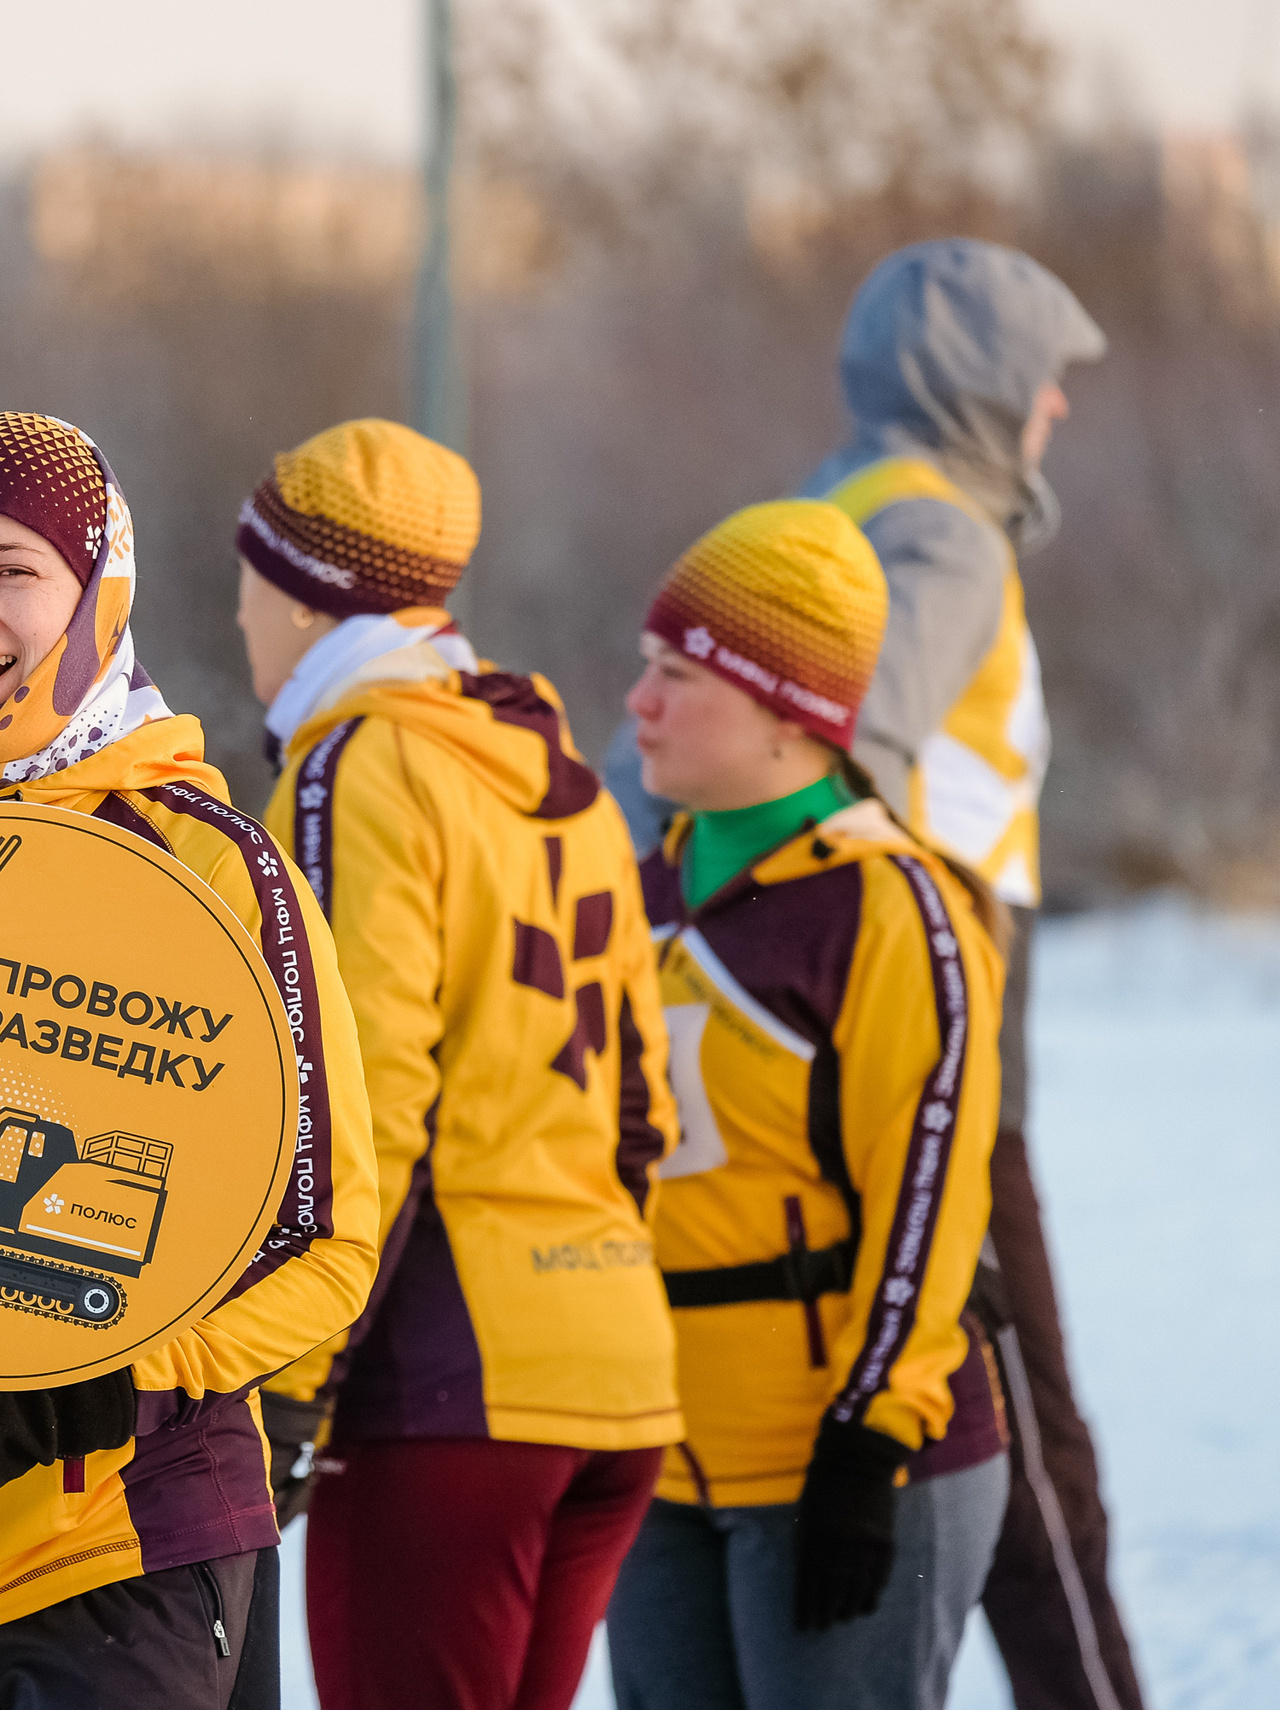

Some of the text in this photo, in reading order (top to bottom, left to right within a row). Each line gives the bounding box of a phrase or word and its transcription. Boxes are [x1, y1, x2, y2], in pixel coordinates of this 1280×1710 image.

[200, 801, 263, 845] ПОЛЮС
[271, 887, 305, 1043] МФЦ ПОЛЮС
[70, 1203, 137, 1229] ПОЛЮС
[297, 1158, 318, 1233] ПОЛЮС
